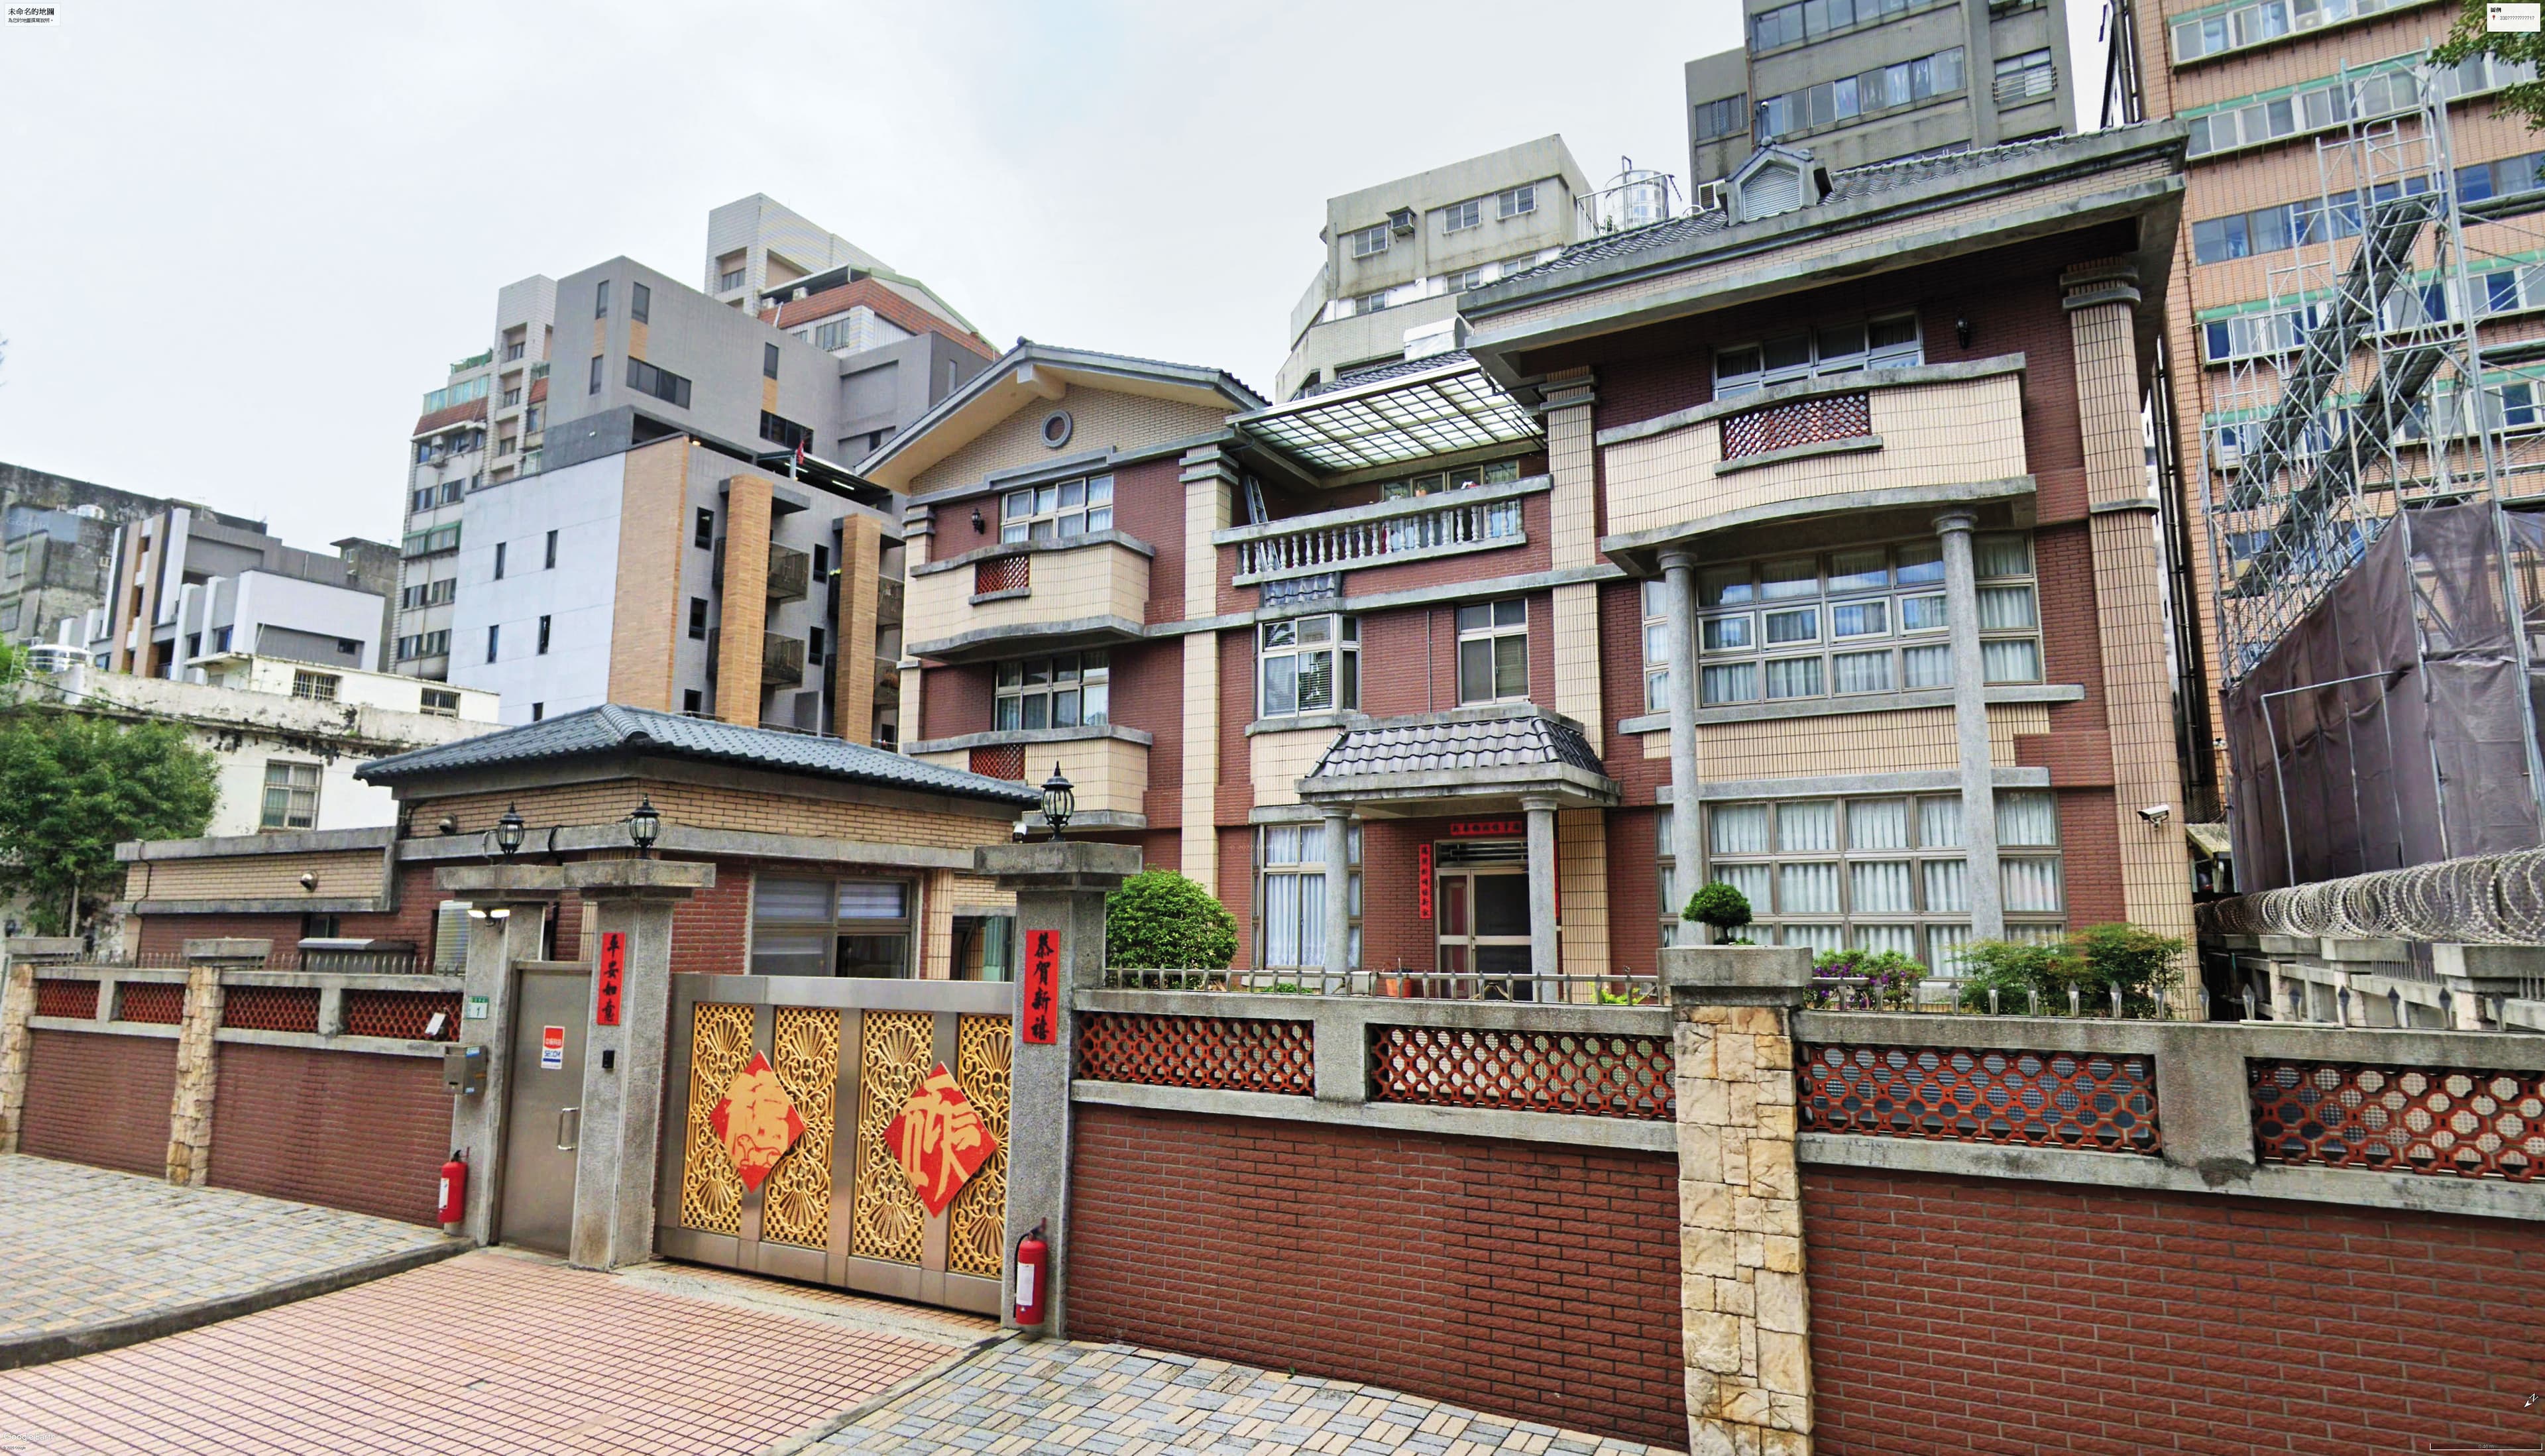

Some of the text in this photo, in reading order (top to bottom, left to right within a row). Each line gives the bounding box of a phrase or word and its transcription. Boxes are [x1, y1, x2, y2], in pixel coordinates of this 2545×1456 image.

[477, 1006, 481, 1017] 1
[602, 934, 620, 1022] 平安如意
[1031, 932, 1054, 1040] 恭賀新禧
